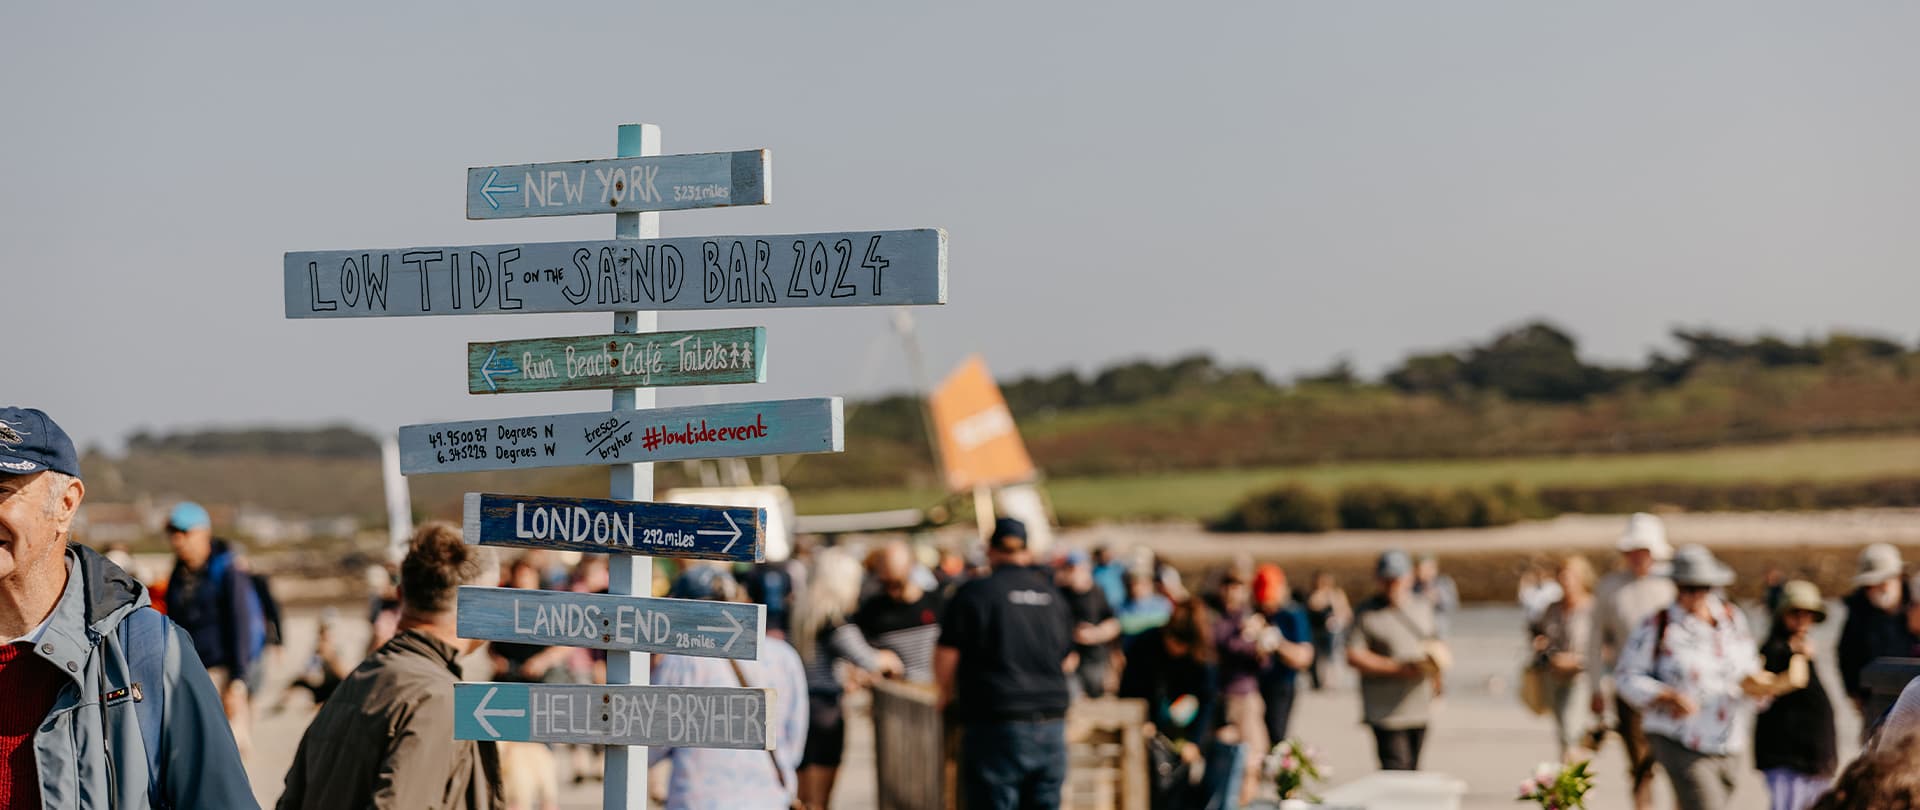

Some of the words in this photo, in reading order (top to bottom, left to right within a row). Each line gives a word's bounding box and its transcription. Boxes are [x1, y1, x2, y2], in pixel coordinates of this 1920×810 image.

[524, 168, 586, 208] NEW
[595, 165, 662, 203] YORK
[309, 253, 389, 311] LOW
[402, 248, 522, 311] TIDE
[523, 270, 539, 284] ON
[544, 267, 564, 285] THE
[561, 243, 684, 305] SAND
[703, 239, 777, 304] BAR
[787, 235, 890, 298] 2024
[523, 351, 558, 379] Ruin
[565, 342, 616, 379] Beach
[621, 341, 662, 385] Café
[670, 334, 728, 373] Toilets
[498, 424, 538, 445] Degrees
[544, 423, 554, 438] N
[584, 417, 619, 443] tresco
[599, 431, 633, 460] bryher
[642, 413, 768, 452] #lowtideevent
[437, 444, 487, 464] 6.345228
[496, 445, 537, 464] Degrees
[544, 442, 556, 457] W
[516, 502, 634, 546] LONDON
[514, 599, 600, 640] LANDS
[615, 605, 671, 645] END
[532, 691, 603, 737] HELL
[611, 691, 659, 738] BAY
[667, 693, 765, 744] BRYHER
